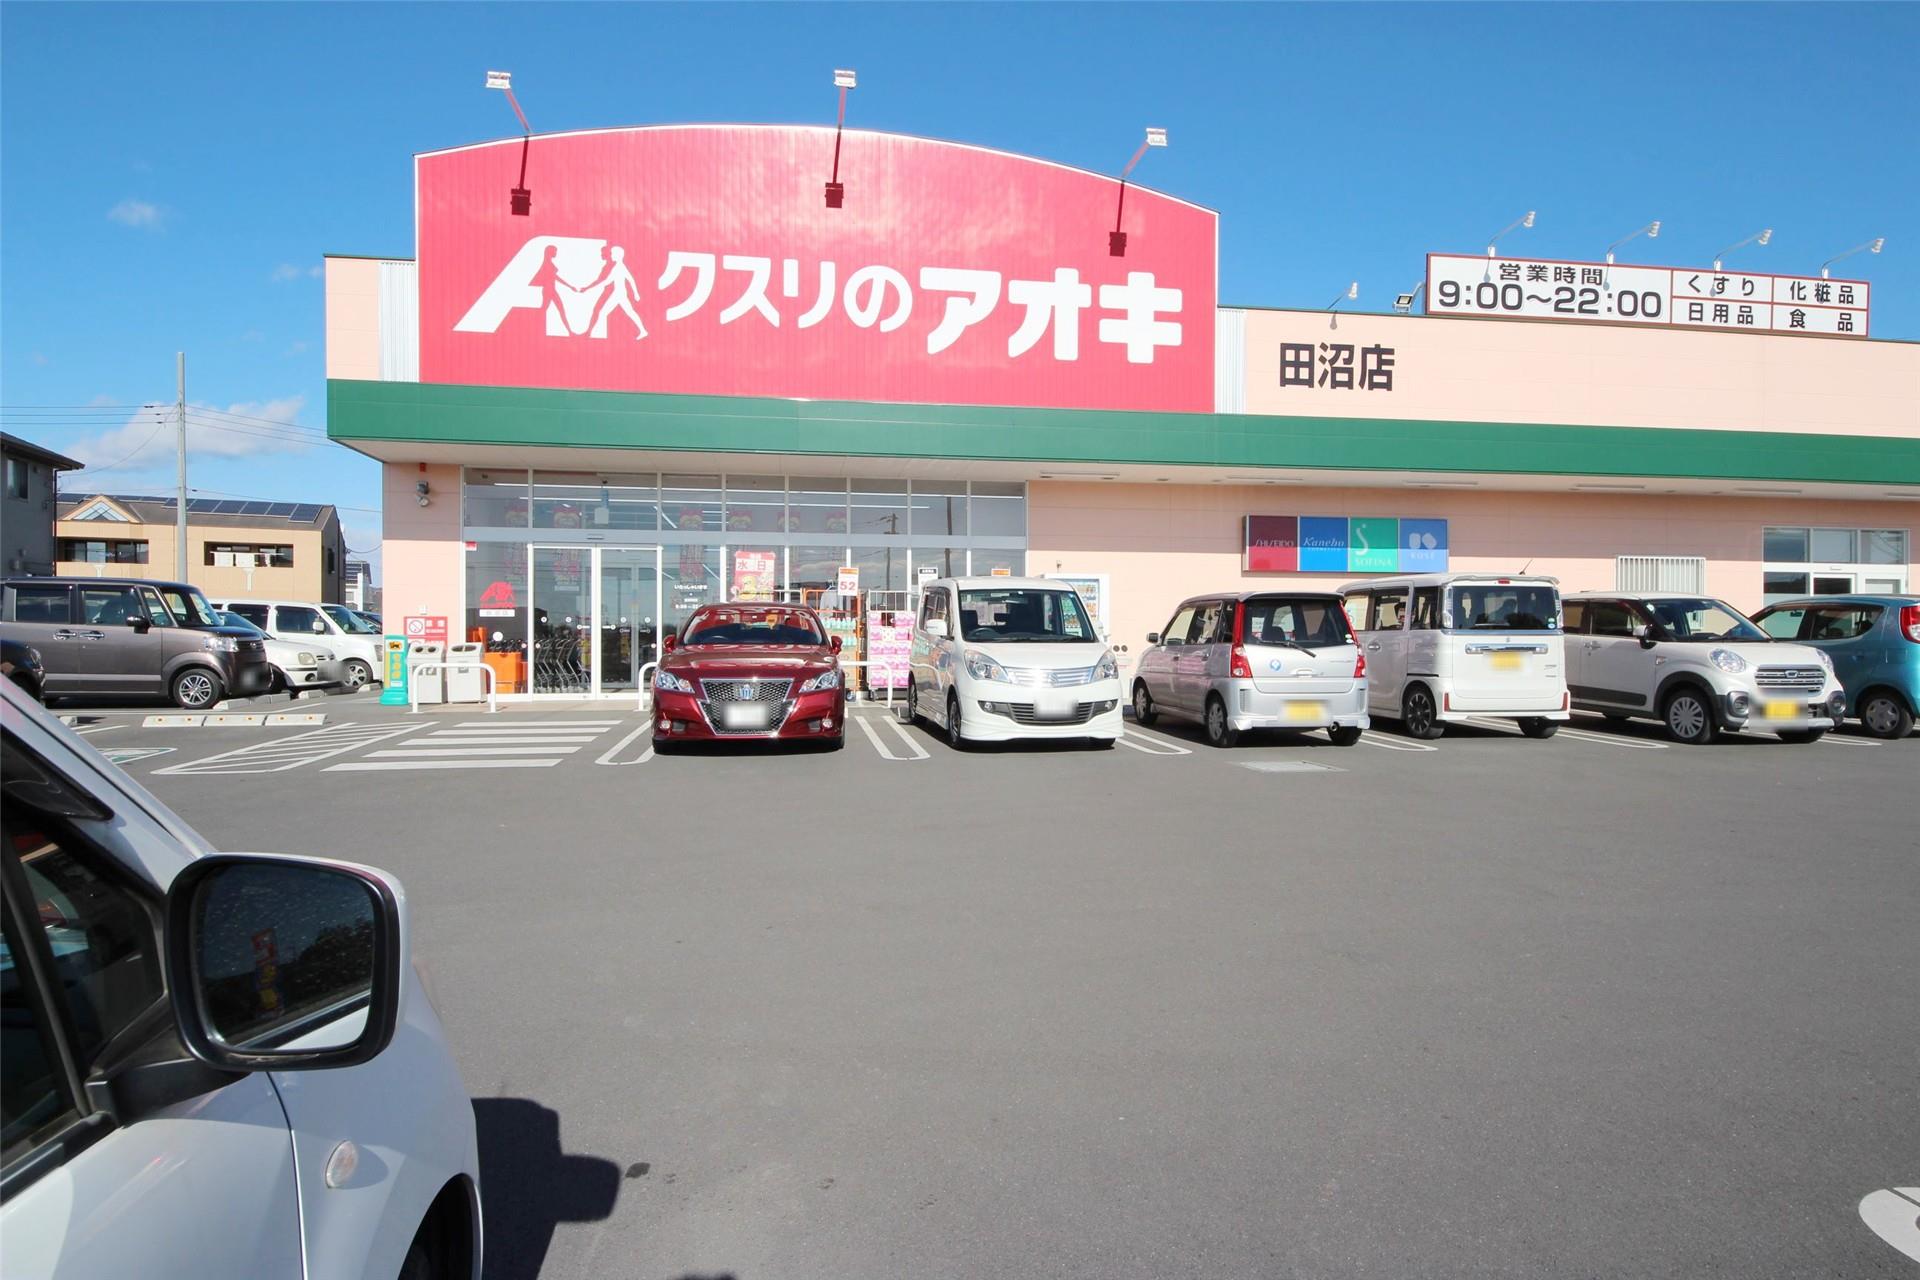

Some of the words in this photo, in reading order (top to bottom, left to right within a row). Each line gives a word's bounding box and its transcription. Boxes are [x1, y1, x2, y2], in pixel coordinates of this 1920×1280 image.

[1499, 263, 1603, 286] 営業時間
[1688, 275, 1755, 297] くすり
[1789, 280, 1854, 305] 化粧品
[657, 250, 1183, 364] クスリのアオキ
[1688, 302, 1754, 325] 日用品
[1279, 342, 1395, 391] 田沼店
[1303, 536, 1345, 547] Kanebo
[1354, 557, 1393, 567] SOFINA
[840, 581, 856, 591] 52
